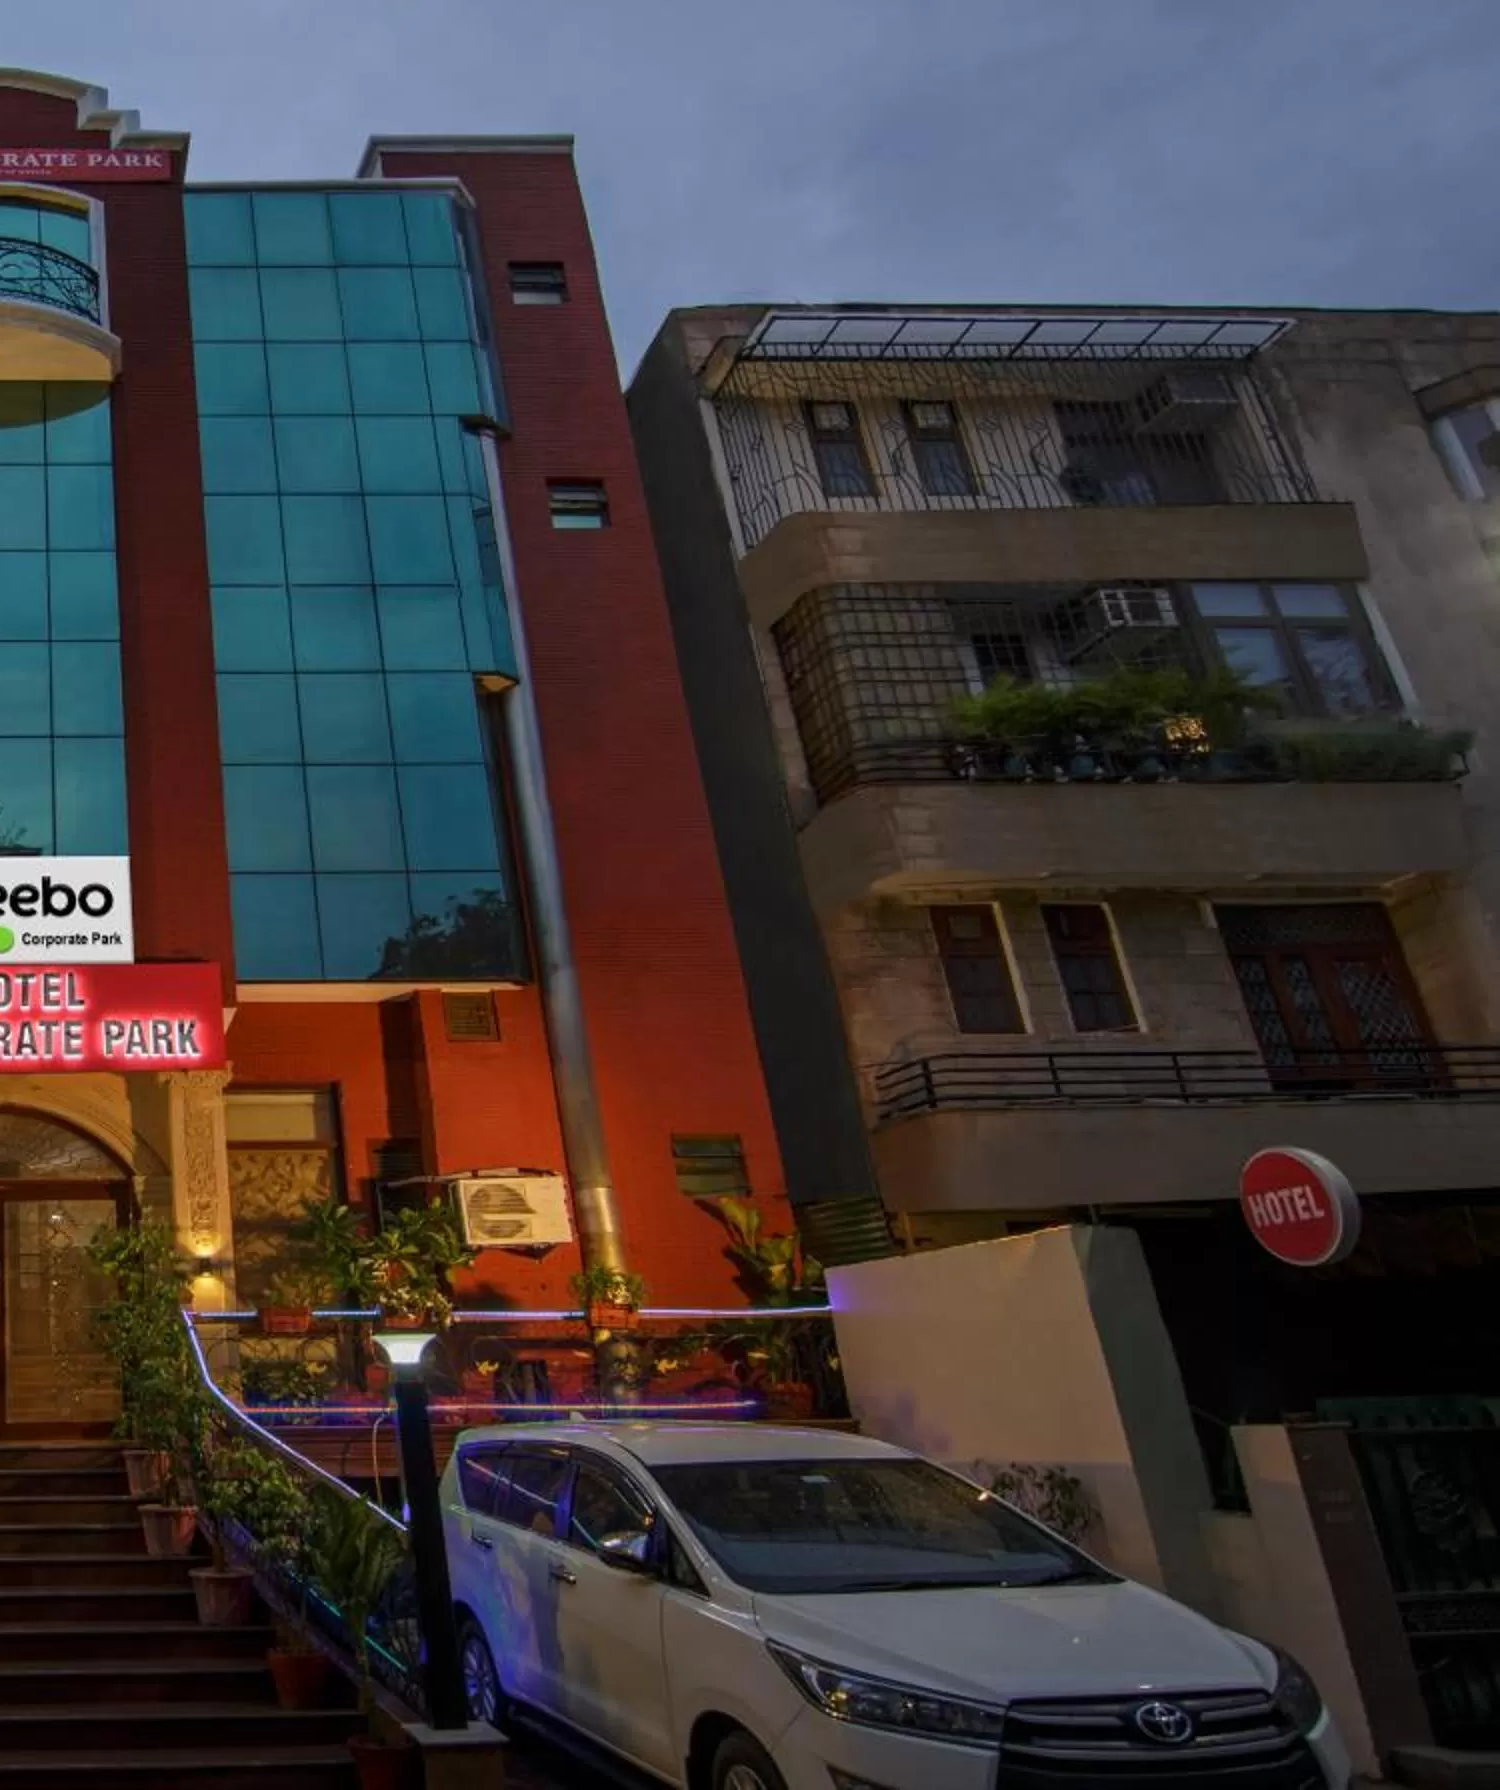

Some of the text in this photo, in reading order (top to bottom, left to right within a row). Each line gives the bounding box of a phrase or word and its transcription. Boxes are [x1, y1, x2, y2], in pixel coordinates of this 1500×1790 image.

[88, 153, 164, 168] PARK
[21, 932, 122, 948] Corporate Park
[102, 1018, 202, 1060] PARK
[1247, 1184, 1325, 1228] HOTEL
